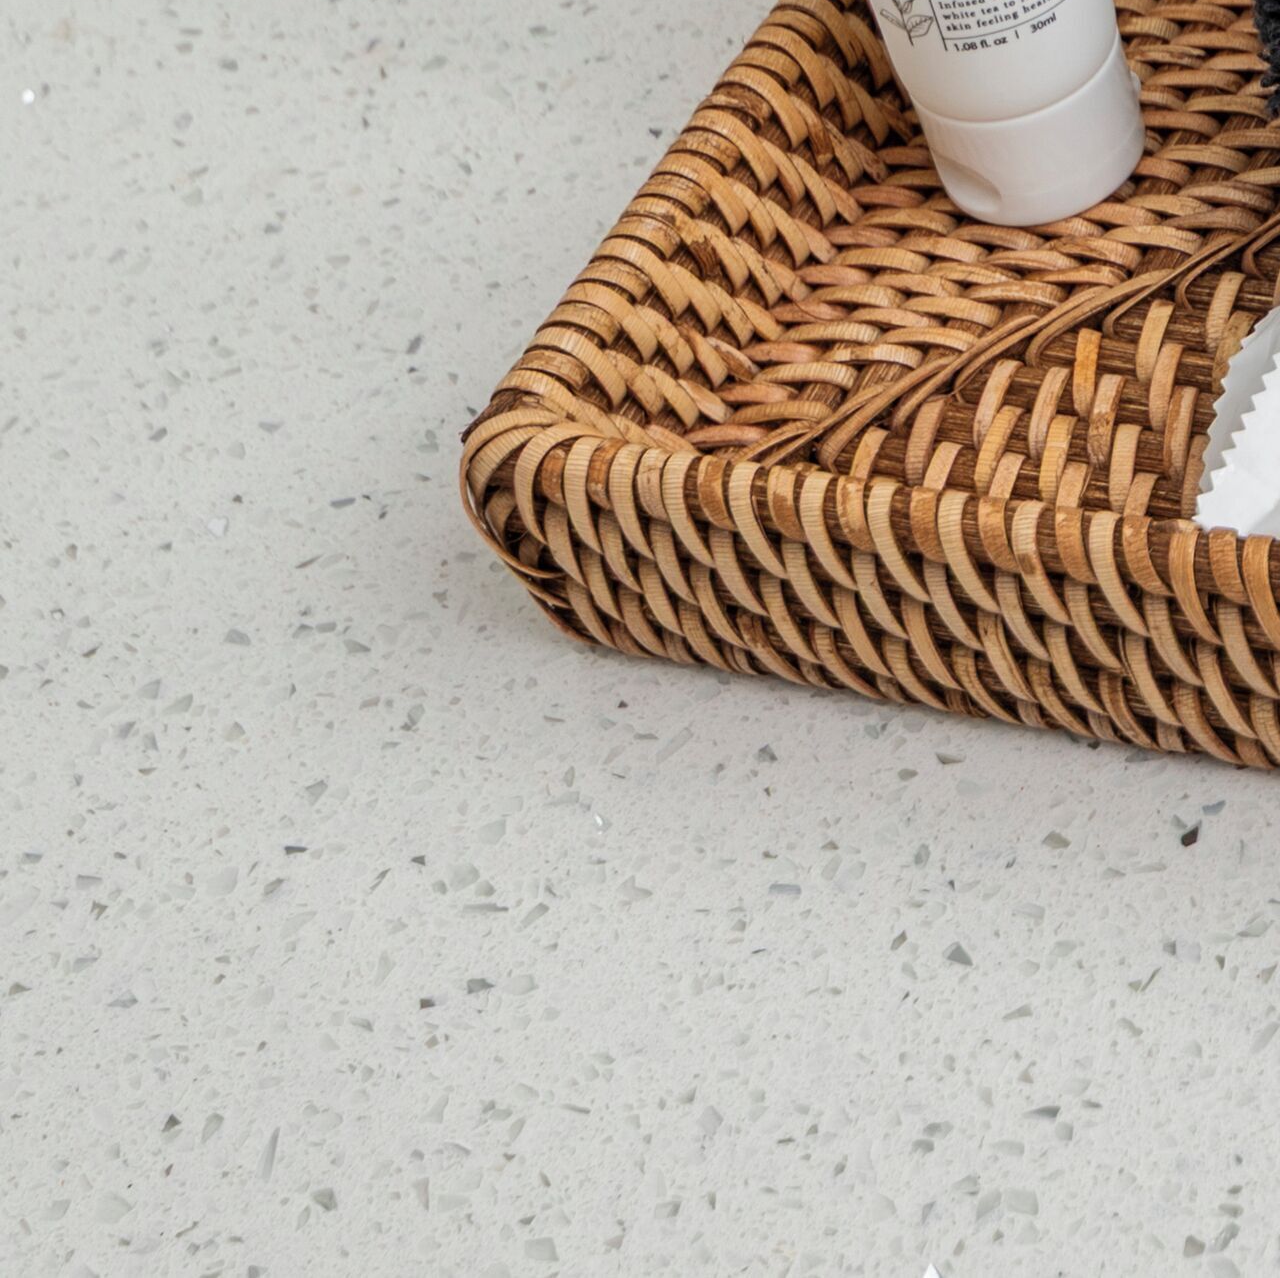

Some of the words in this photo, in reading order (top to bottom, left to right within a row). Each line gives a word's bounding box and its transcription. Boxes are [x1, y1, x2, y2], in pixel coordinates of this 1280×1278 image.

[942, 9, 976, 21] white
[981, 5, 1000, 15] tea
[1003, 0, 1016, 9] to
[946, 21, 971, 32] skin
[976, 11, 1019, 28] feeling
[954, 41, 978, 52] 1.08
[994, 36, 1008, 46] oz
[1030, 12, 1057, 34] 30ml
